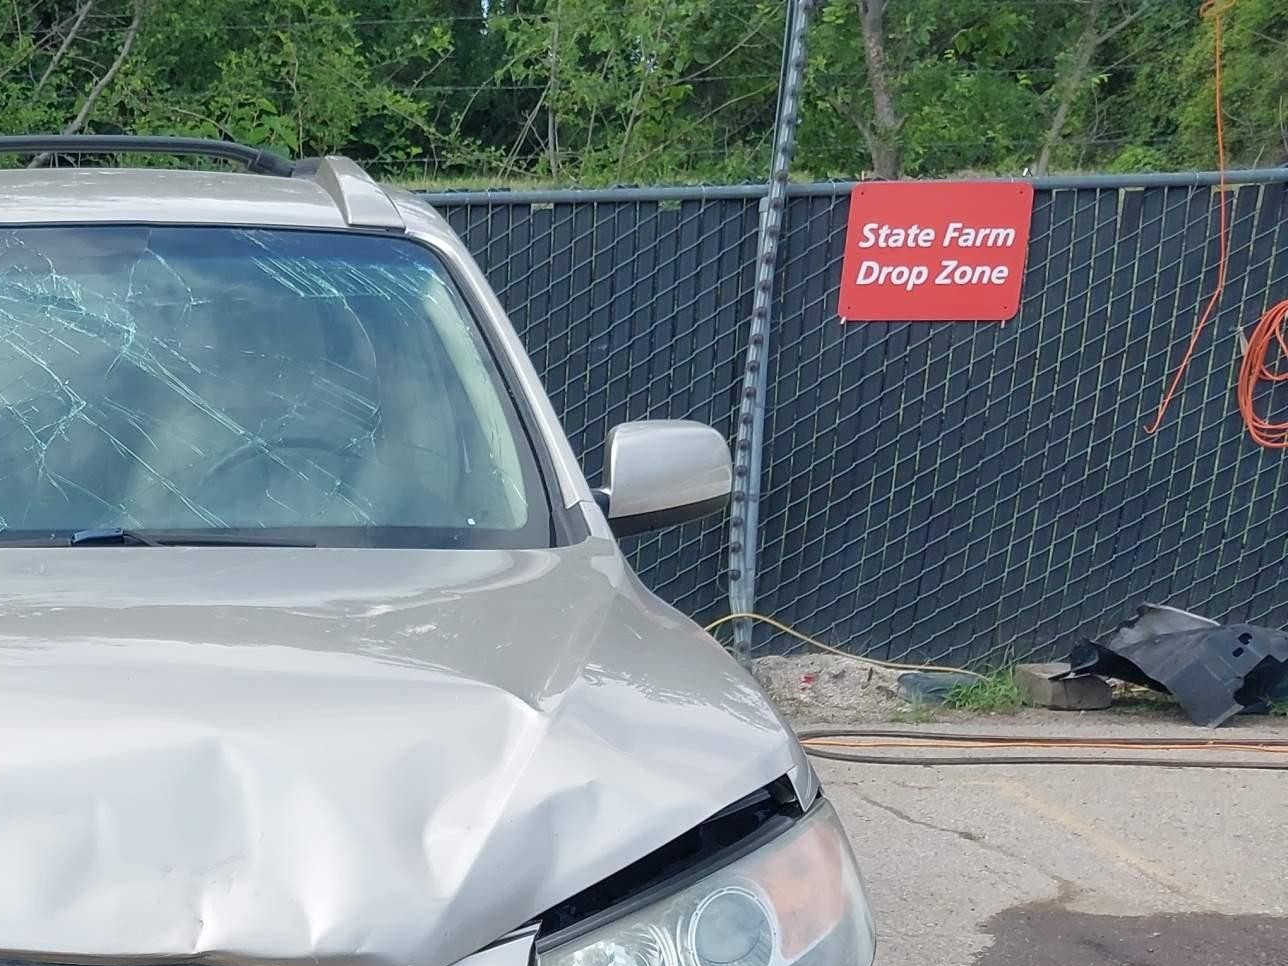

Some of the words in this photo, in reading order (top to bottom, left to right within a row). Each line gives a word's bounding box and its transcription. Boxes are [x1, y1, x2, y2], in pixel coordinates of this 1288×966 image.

[858, 222, 936, 248] State
[942, 222, 1016, 248] Farm
[856, 260, 929, 291] Drop
[935, 260, 1009, 285] Zone
